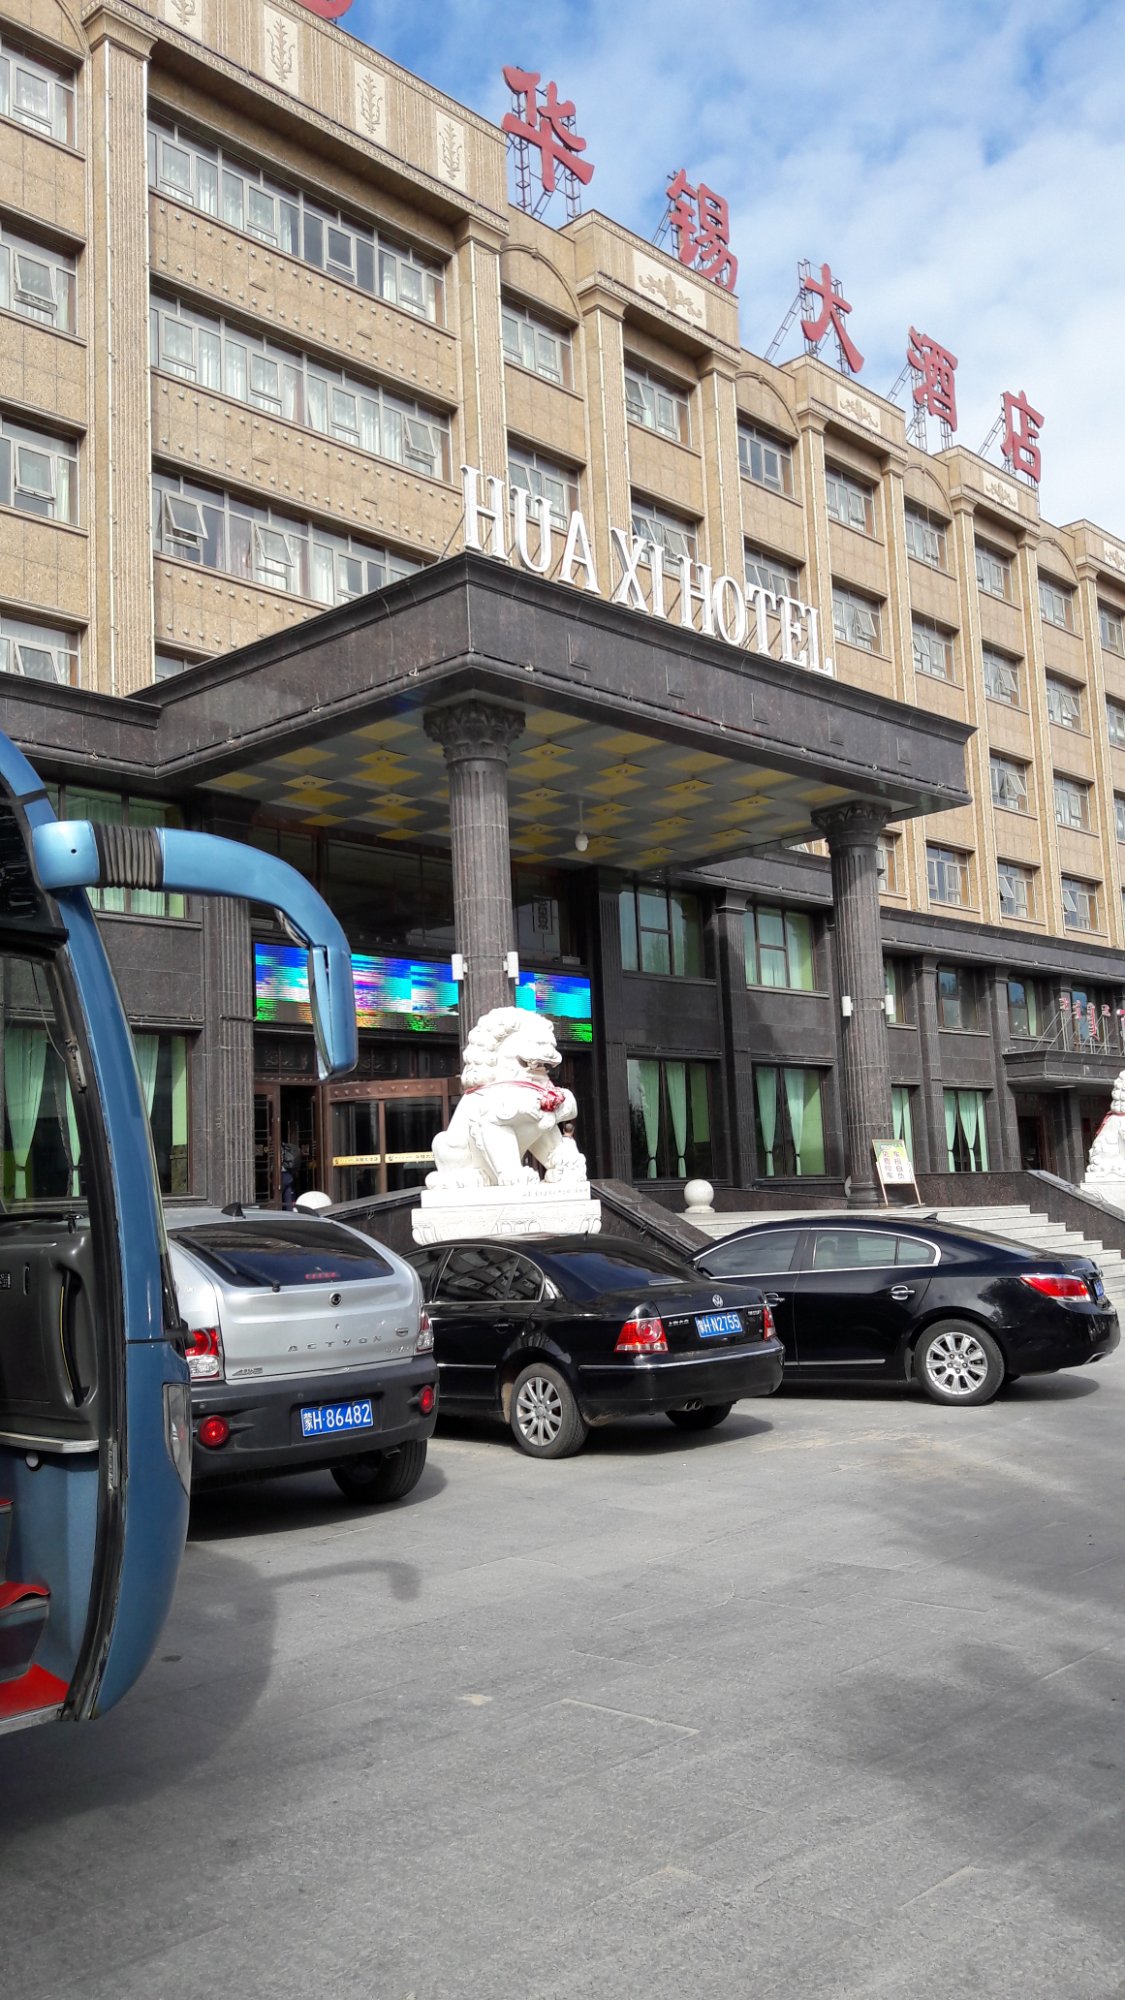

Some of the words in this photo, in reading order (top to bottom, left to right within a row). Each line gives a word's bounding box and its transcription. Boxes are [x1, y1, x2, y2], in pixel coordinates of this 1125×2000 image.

[459, 464, 602, 595] HUA
[677, 552, 834, 678] HOTEL
[288, 1335, 382, 1352] ACTYON
